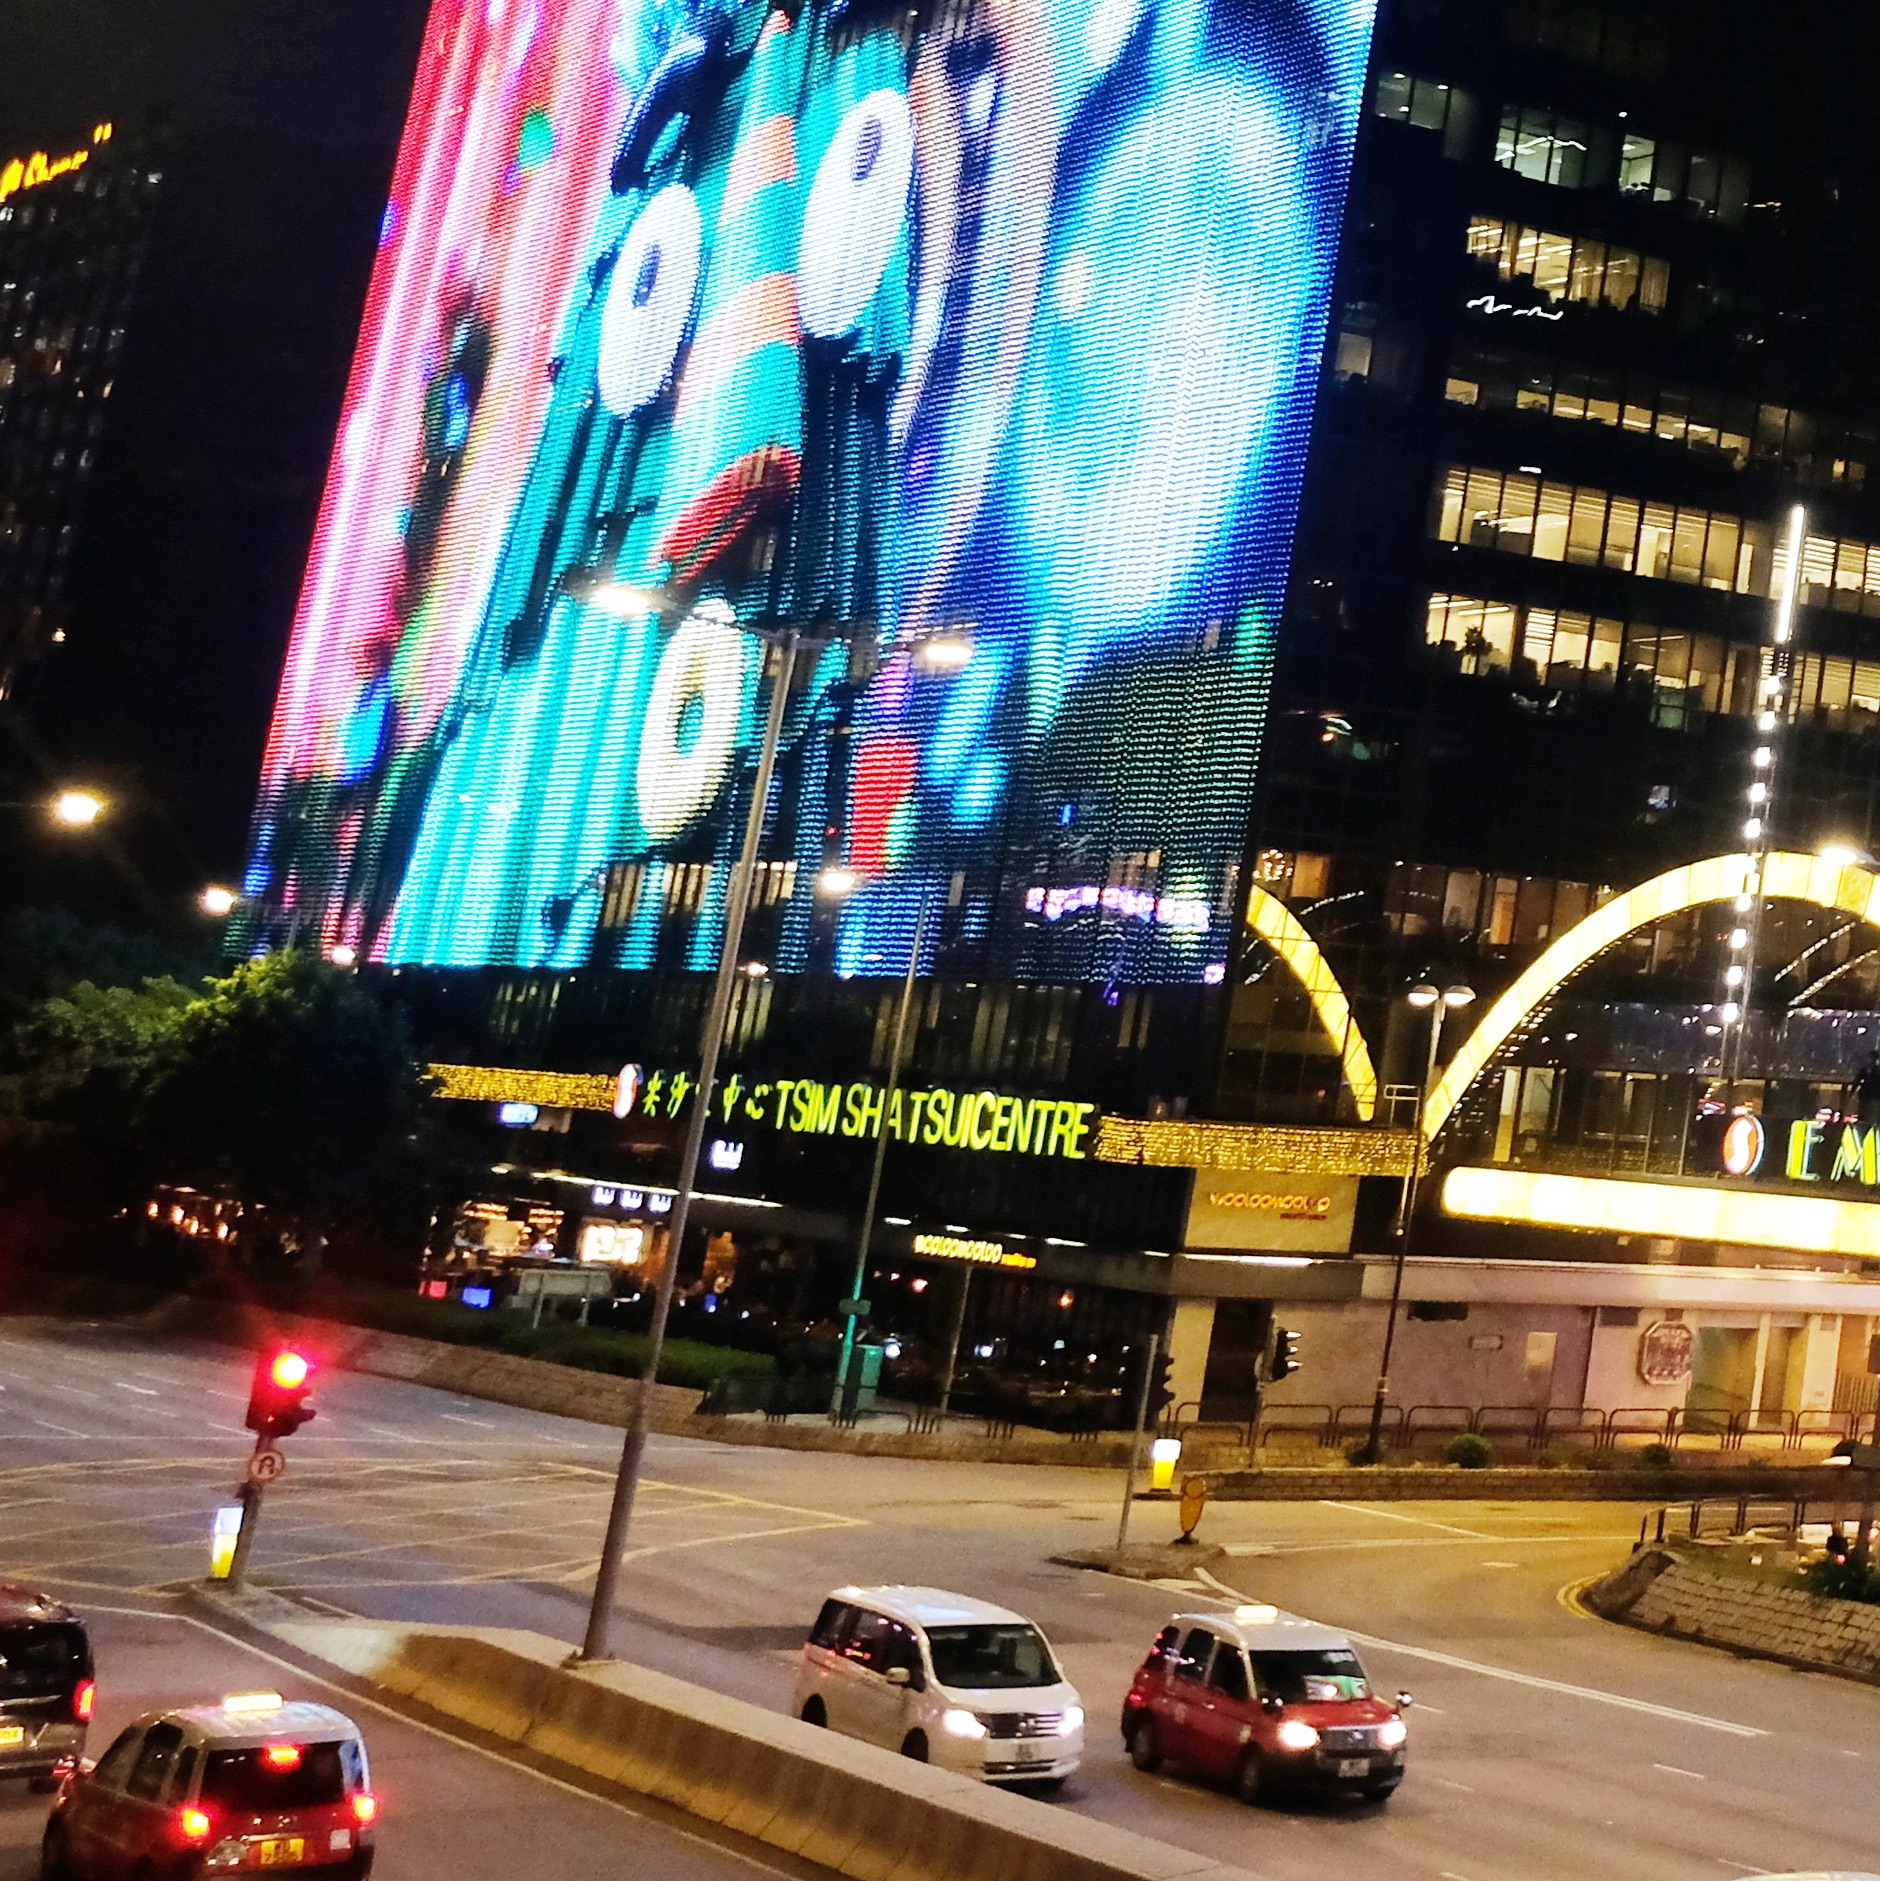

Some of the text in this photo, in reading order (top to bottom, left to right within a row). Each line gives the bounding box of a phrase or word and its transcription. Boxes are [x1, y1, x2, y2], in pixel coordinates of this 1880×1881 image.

[642, 1069, 770, 1124] 尖沙中心
[774, 1079, 842, 1135] TSIM
[841, 1082, 903, 1141] SHA
